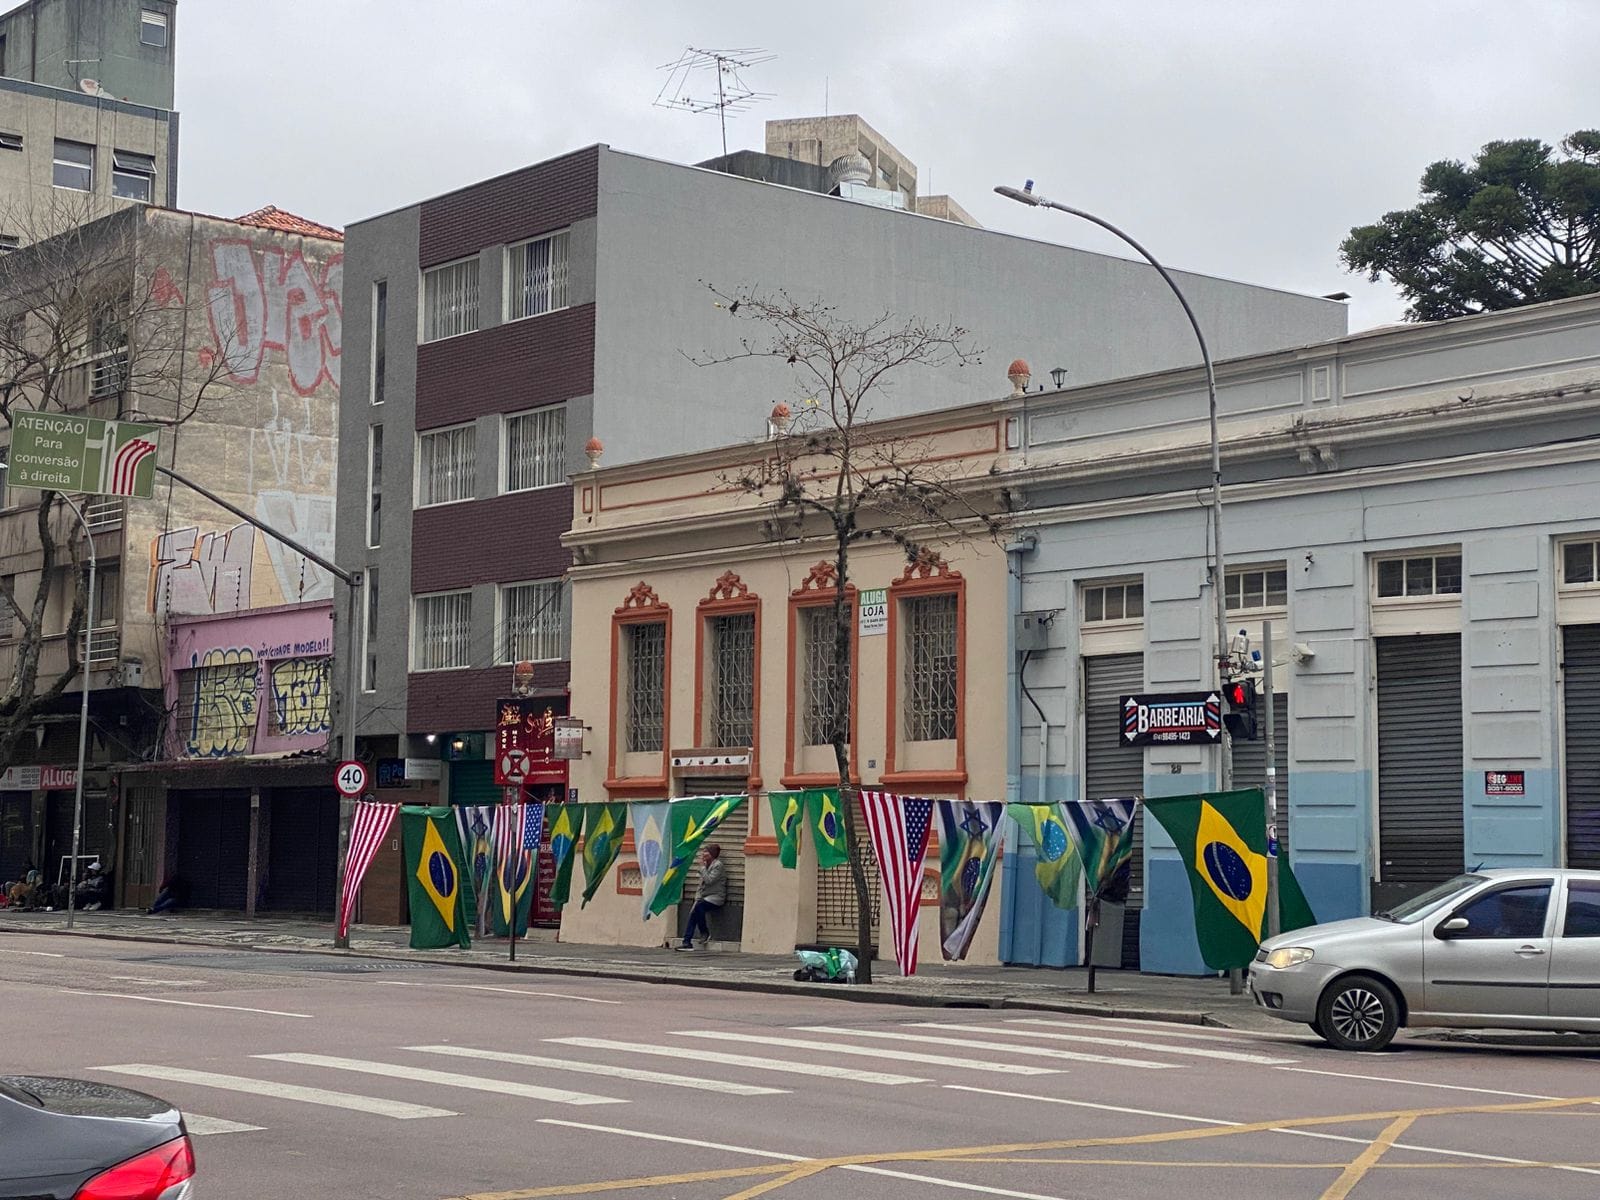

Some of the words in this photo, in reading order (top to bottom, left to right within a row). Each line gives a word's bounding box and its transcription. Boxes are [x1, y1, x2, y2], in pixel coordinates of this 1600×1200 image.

[17, 416, 85, 435] ATENÇÃO
[35, 436, 63, 449] Para
[14, 453, 79, 468] conversão
[20, 469, 28, 481] à
[30, 470, 71, 484] direita
[860, 590, 888, 605] ALUGA
[863, 605, 885, 617] LOJA
[1137, 704, 1206, 733] BARBEARIA
[341, 768, 362, 784] 40
